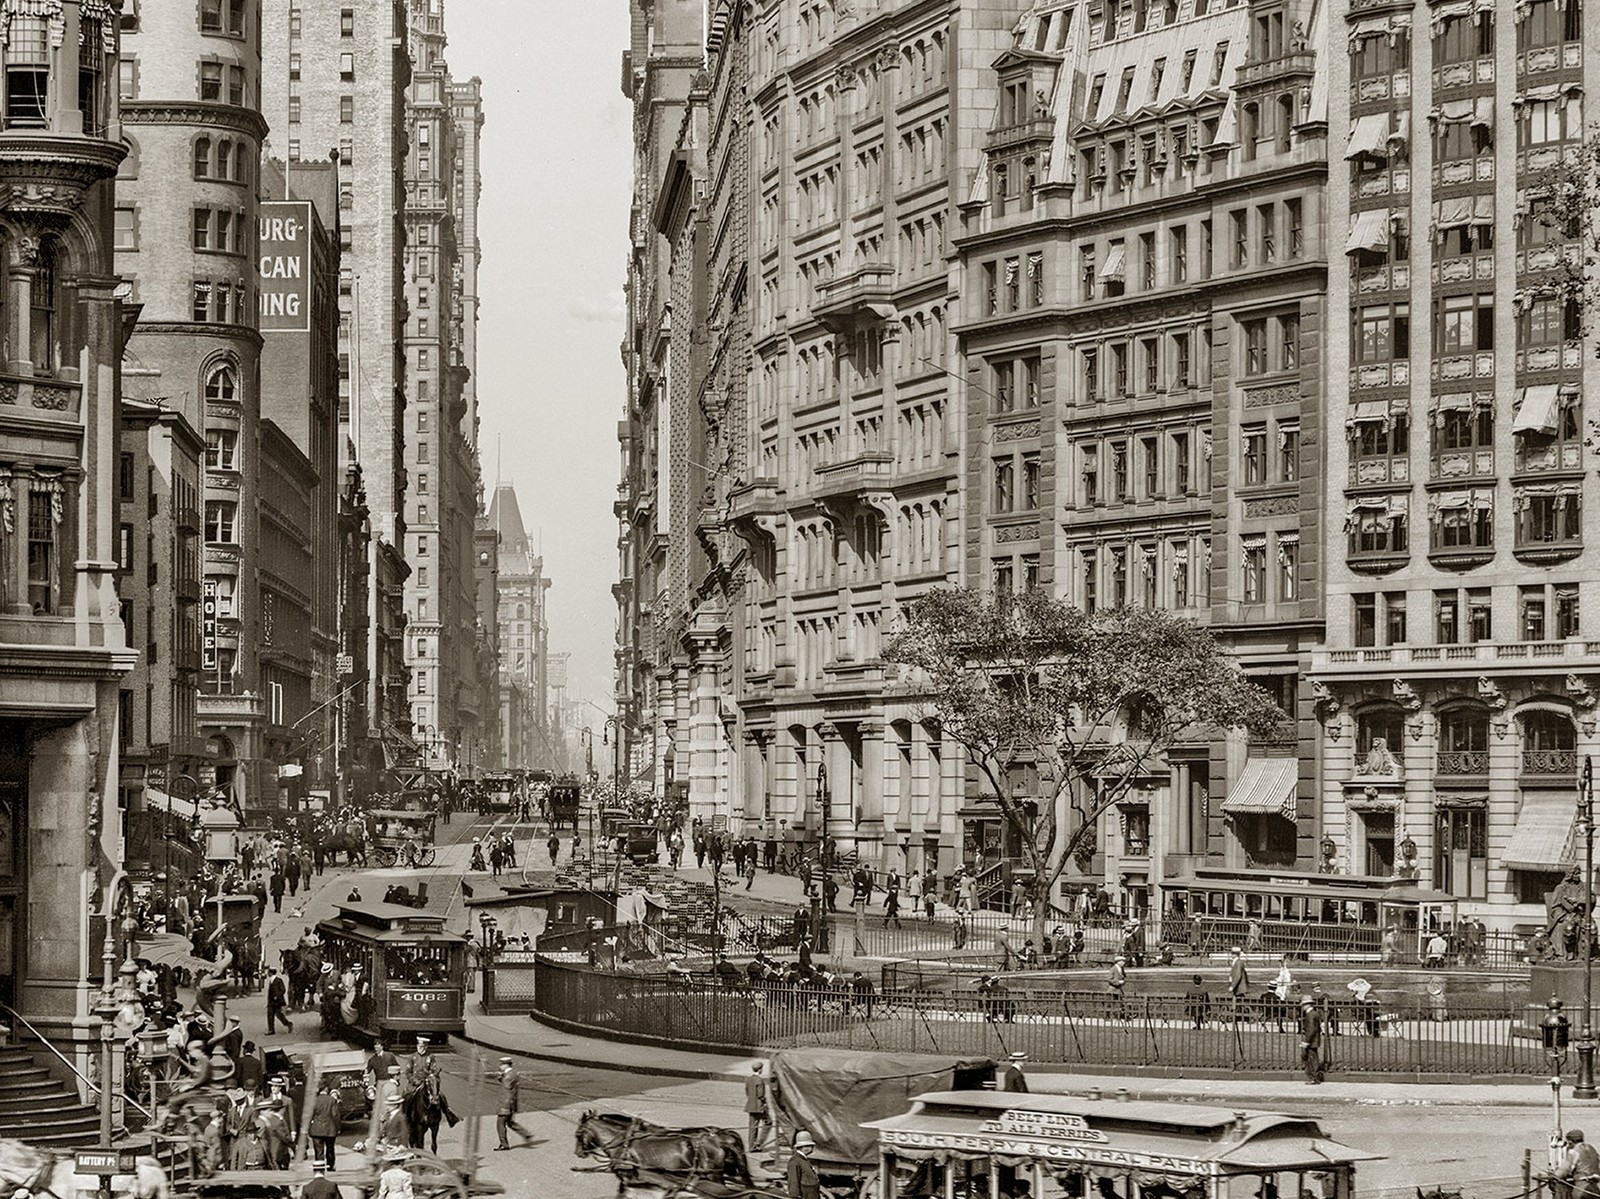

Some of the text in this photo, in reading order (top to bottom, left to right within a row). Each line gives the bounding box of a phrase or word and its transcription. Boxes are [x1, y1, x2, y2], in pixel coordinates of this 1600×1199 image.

[260, 256, 301, 279] CAN
[259, 293, 301, 316] ING
[203, 584, 215, 666] HOTEL
[401, 993, 447, 1001] 4082
[1007, 1111, 1081, 1127] BELT LINE
[986, 1121, 1101, 1141] TO ALL FERRIES
[883, 1131, 1207, 1173] SOUTH FERRY & CENTRAL PARK
